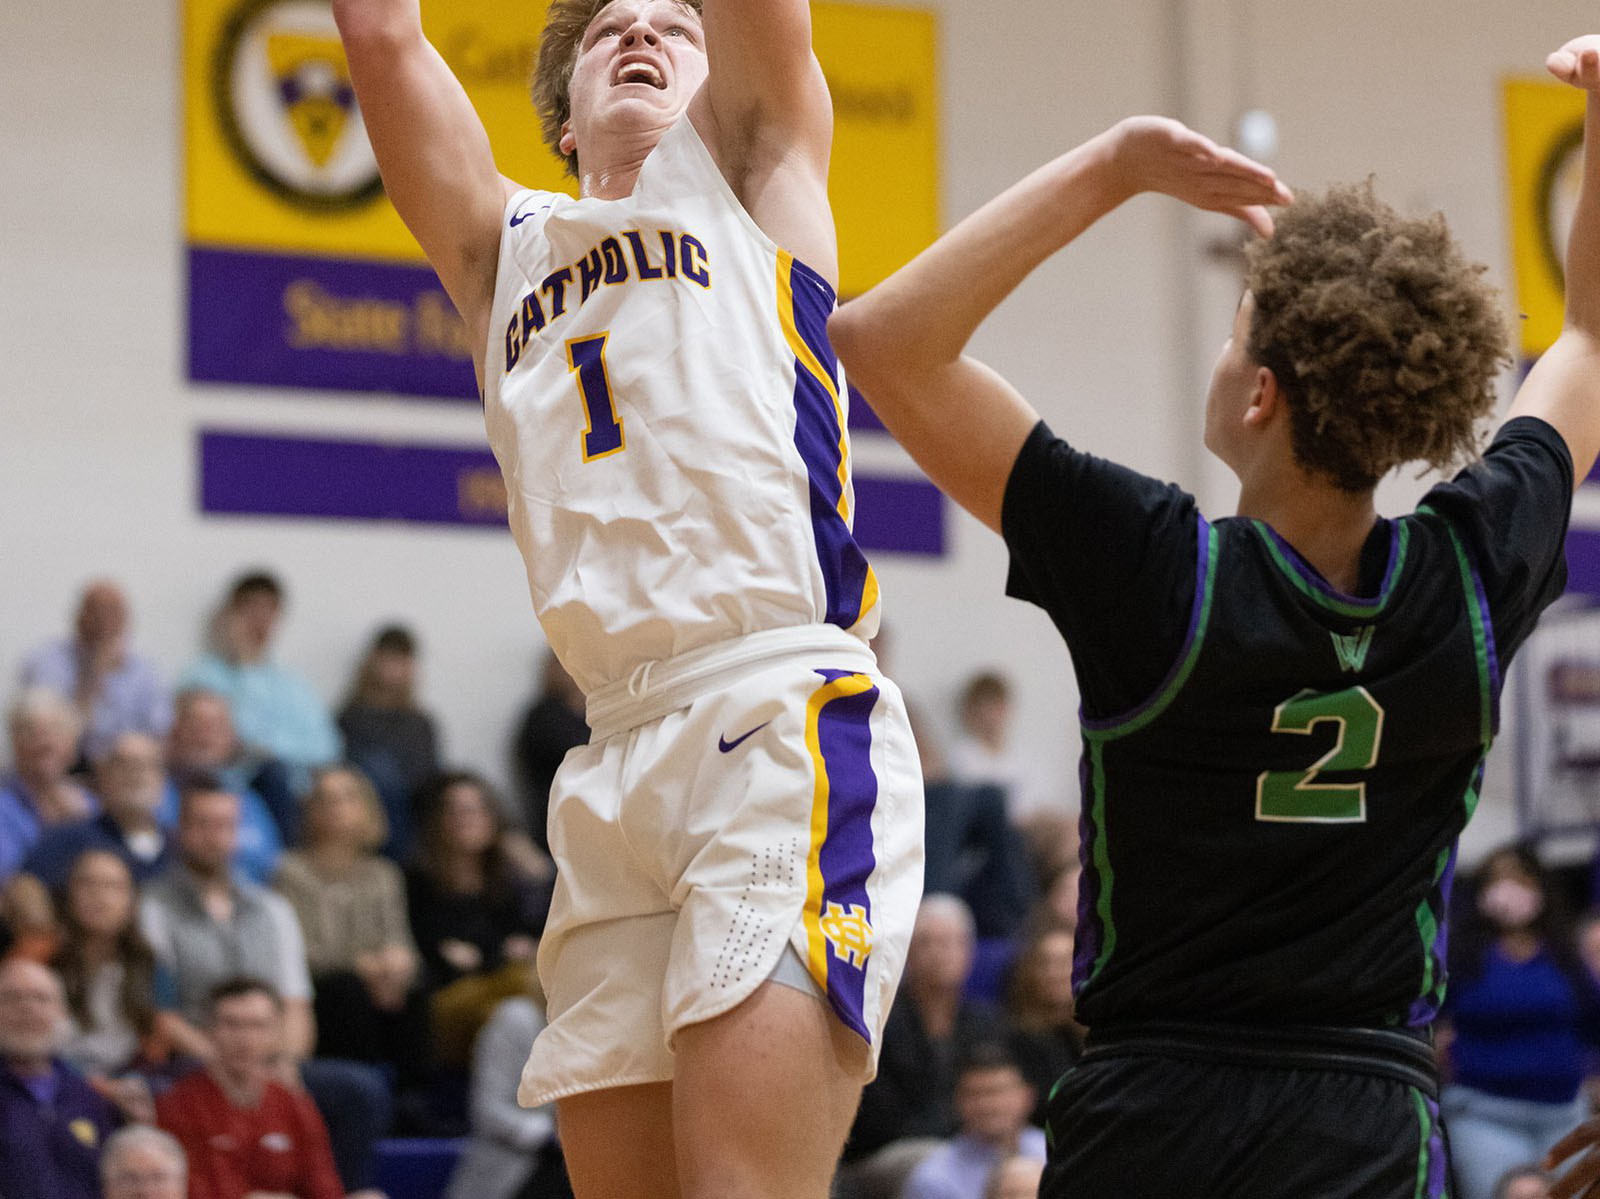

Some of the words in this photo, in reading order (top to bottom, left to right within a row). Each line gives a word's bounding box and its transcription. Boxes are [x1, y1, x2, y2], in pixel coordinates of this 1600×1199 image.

[505, 230, 711, 374] CATHOLIC
[565, 332, 627, 467] 1
[1255, 686, 1384, 823] 2
